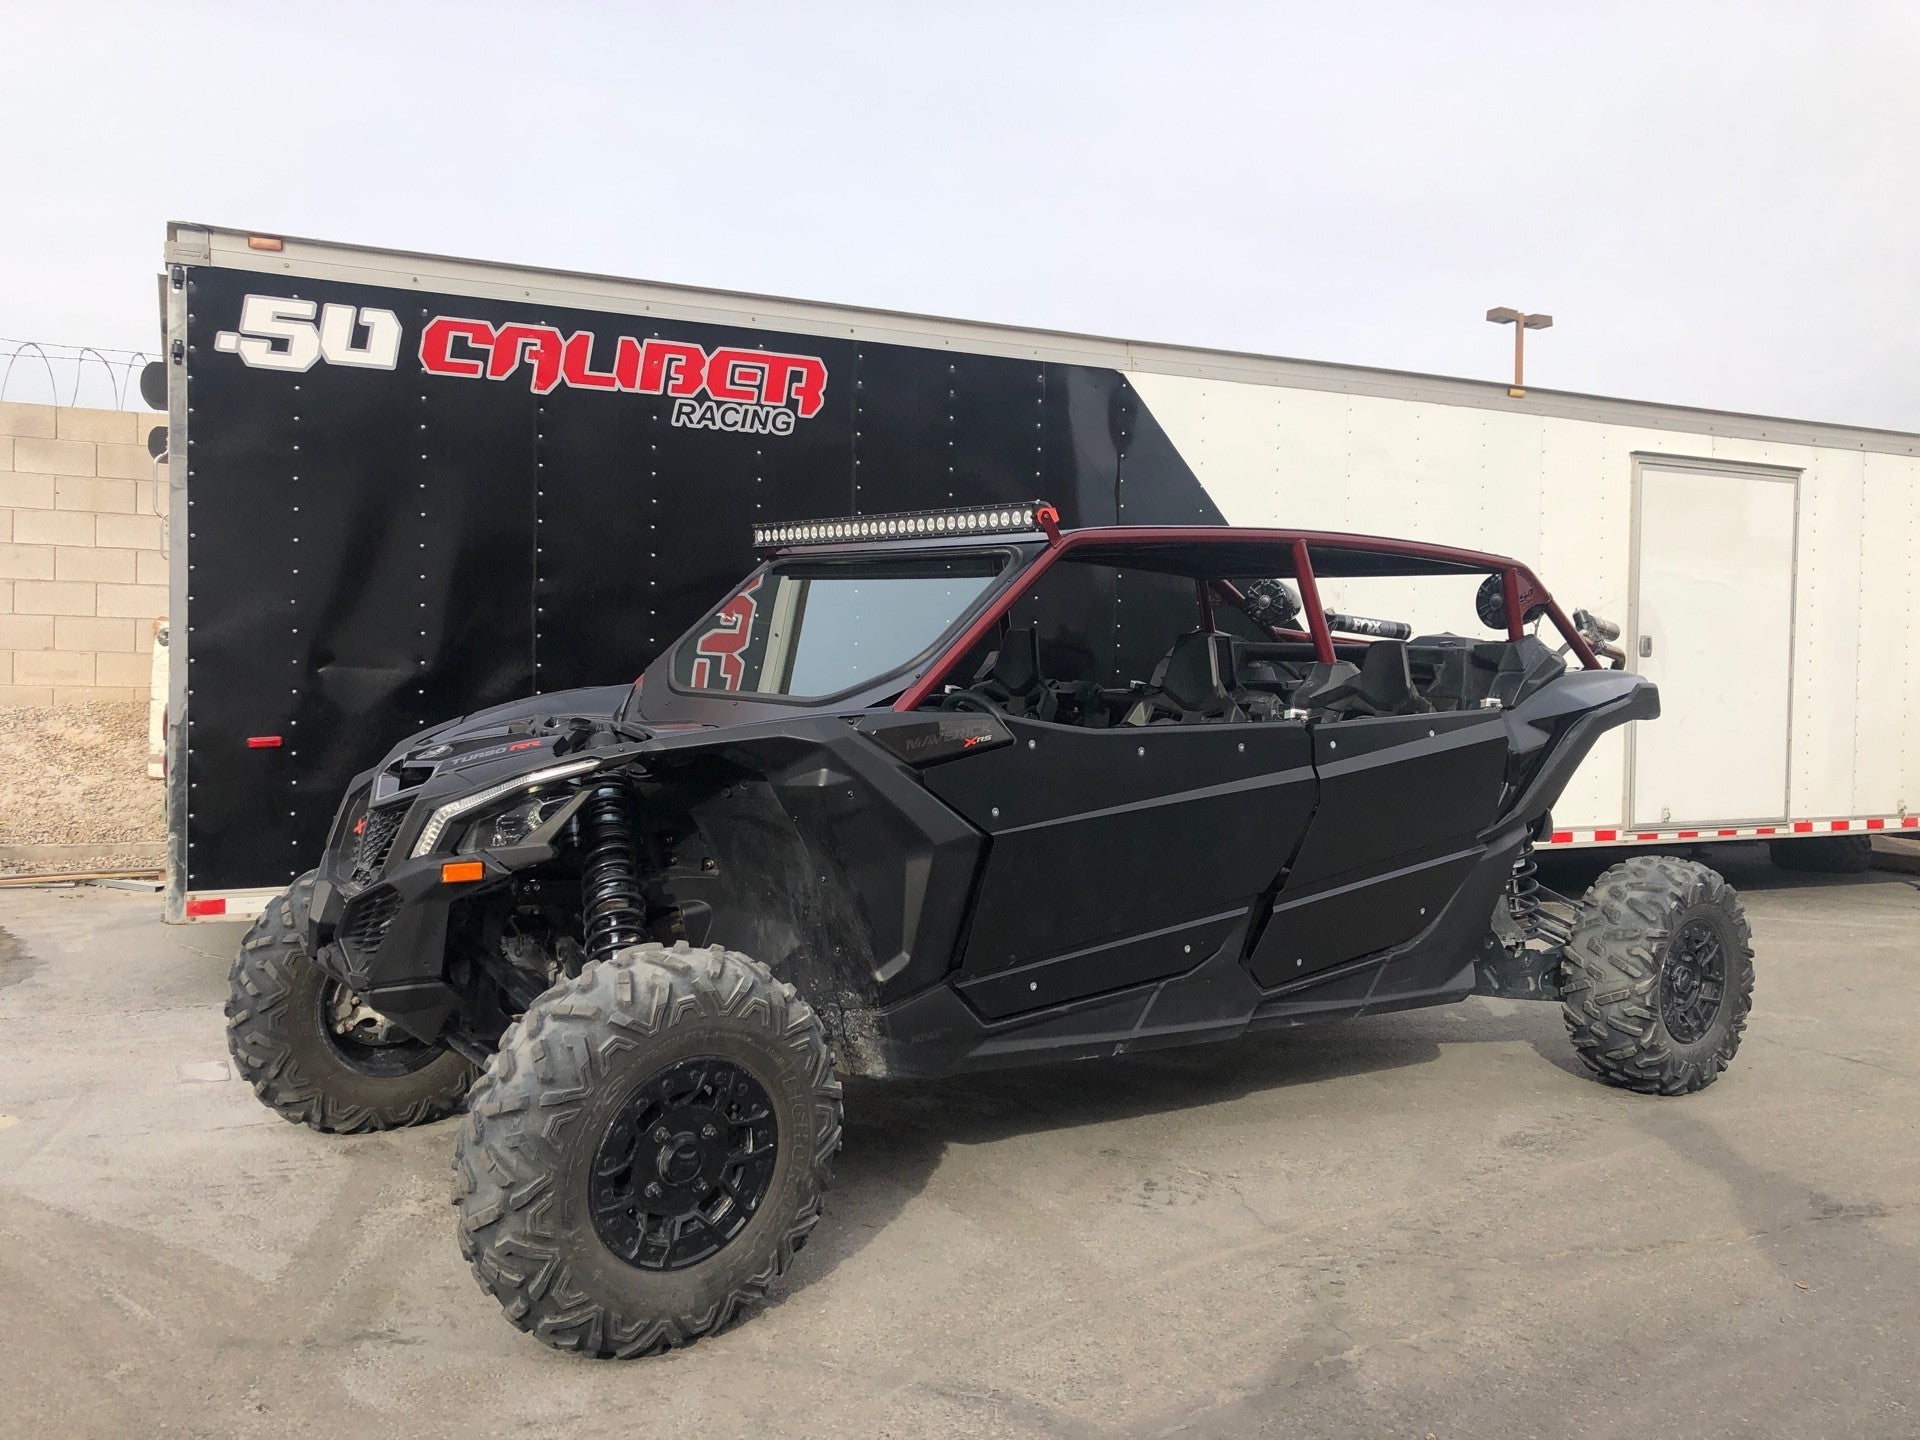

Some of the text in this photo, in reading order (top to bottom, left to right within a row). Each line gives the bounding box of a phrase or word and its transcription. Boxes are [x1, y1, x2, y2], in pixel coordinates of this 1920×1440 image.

[418, 314, 829, 419] CALIBER
[670, 401, 796, 437] RACING
[1352, 618, 1382, 633] FOX
[451, 747, 507, 765] TURBO
